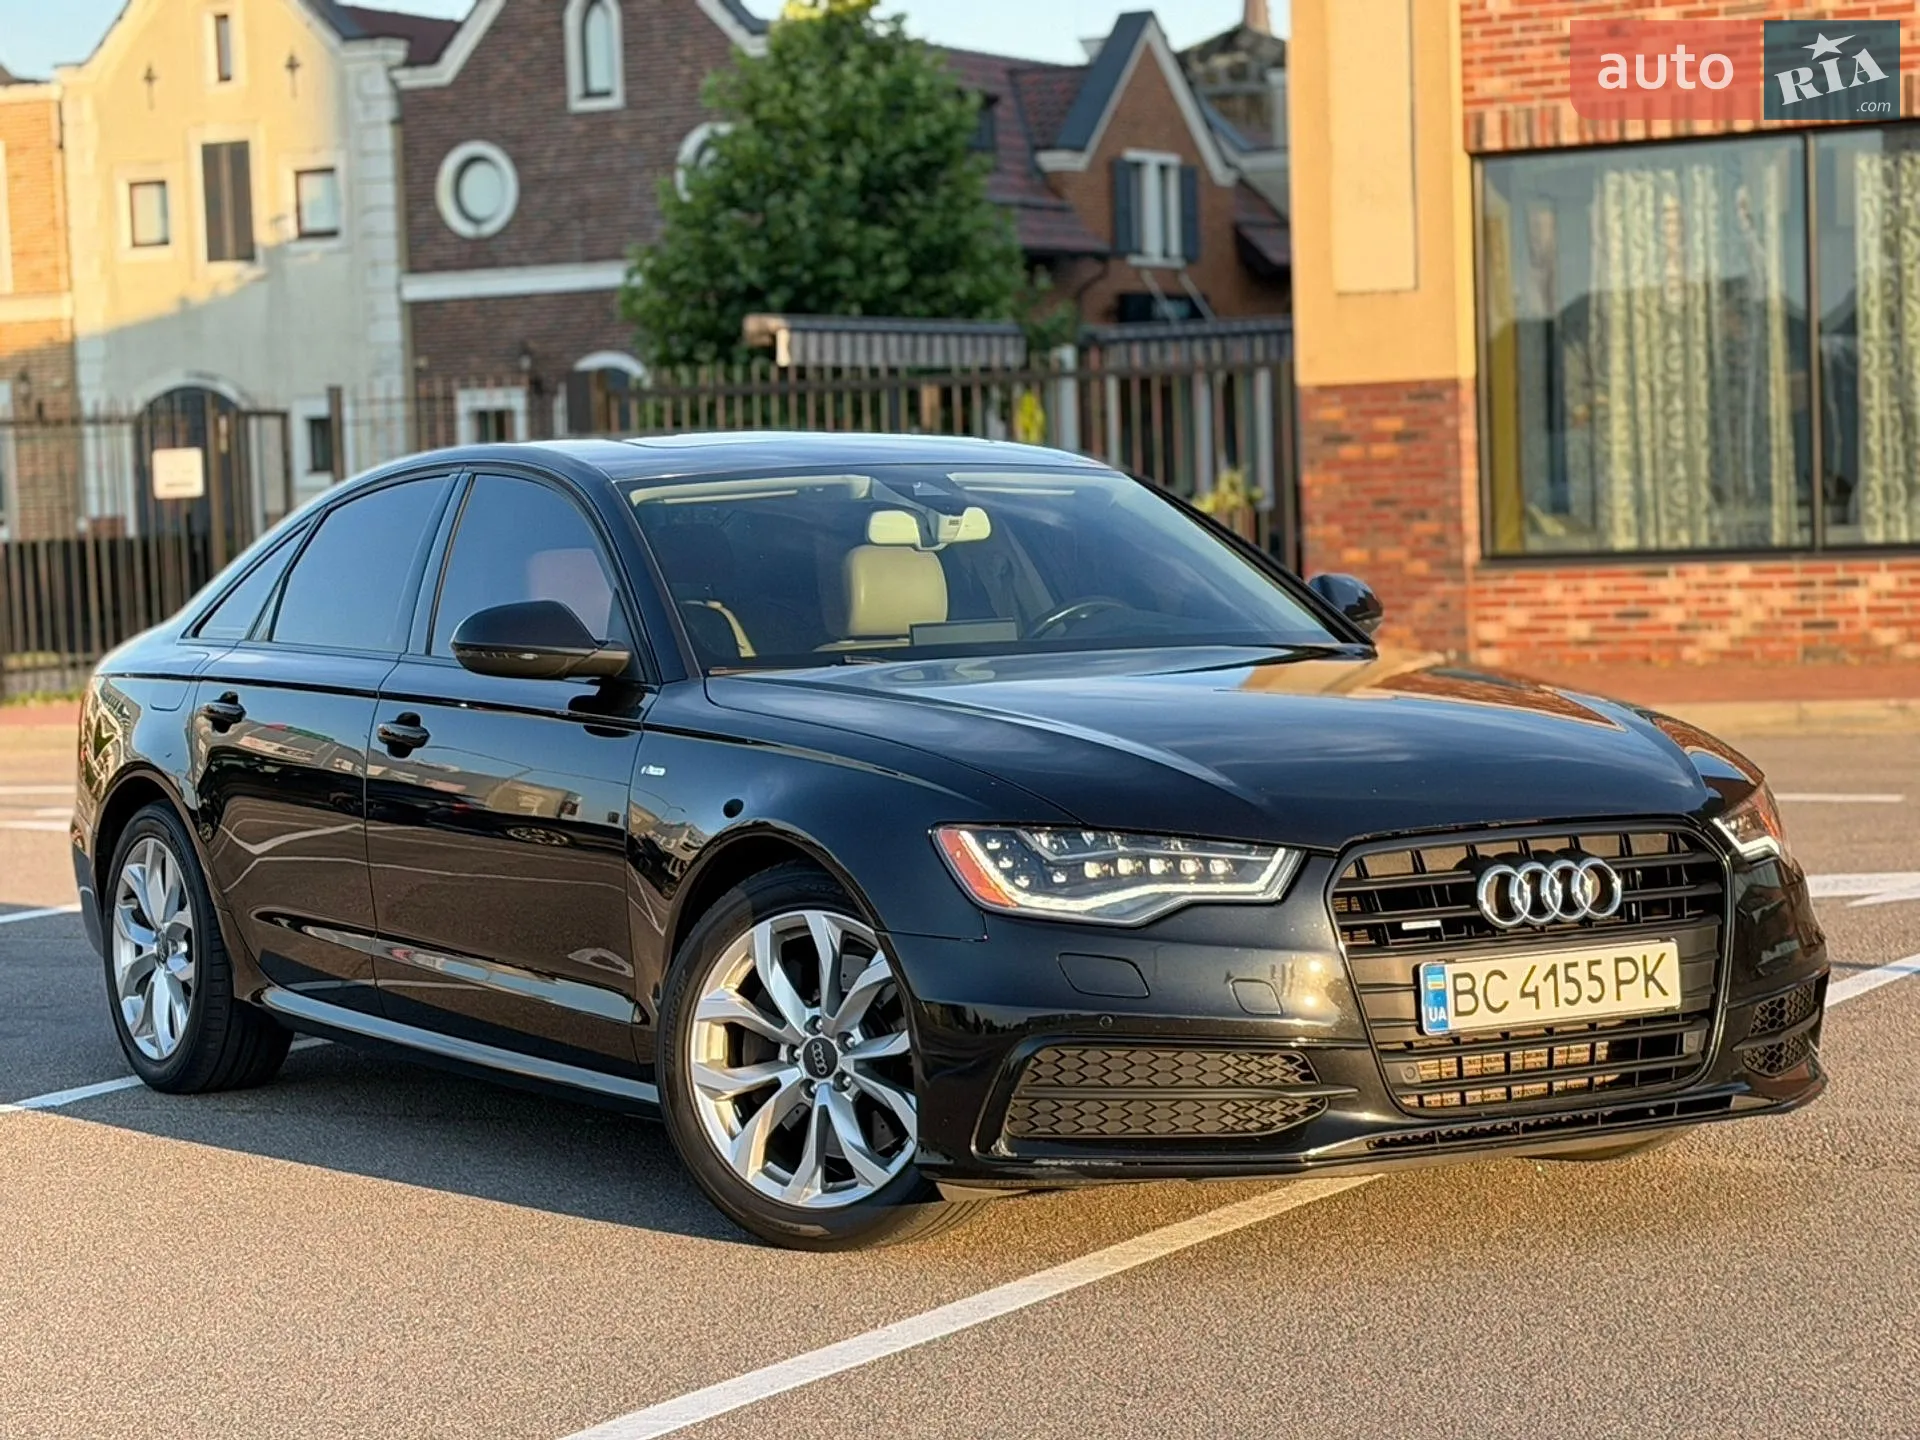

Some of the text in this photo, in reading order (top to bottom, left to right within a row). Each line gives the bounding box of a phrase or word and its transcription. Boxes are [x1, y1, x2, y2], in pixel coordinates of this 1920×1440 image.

[1452, 952, 1669, 1017] BC 4155 PK
[1428, 1006, 1447, 1022] UA
